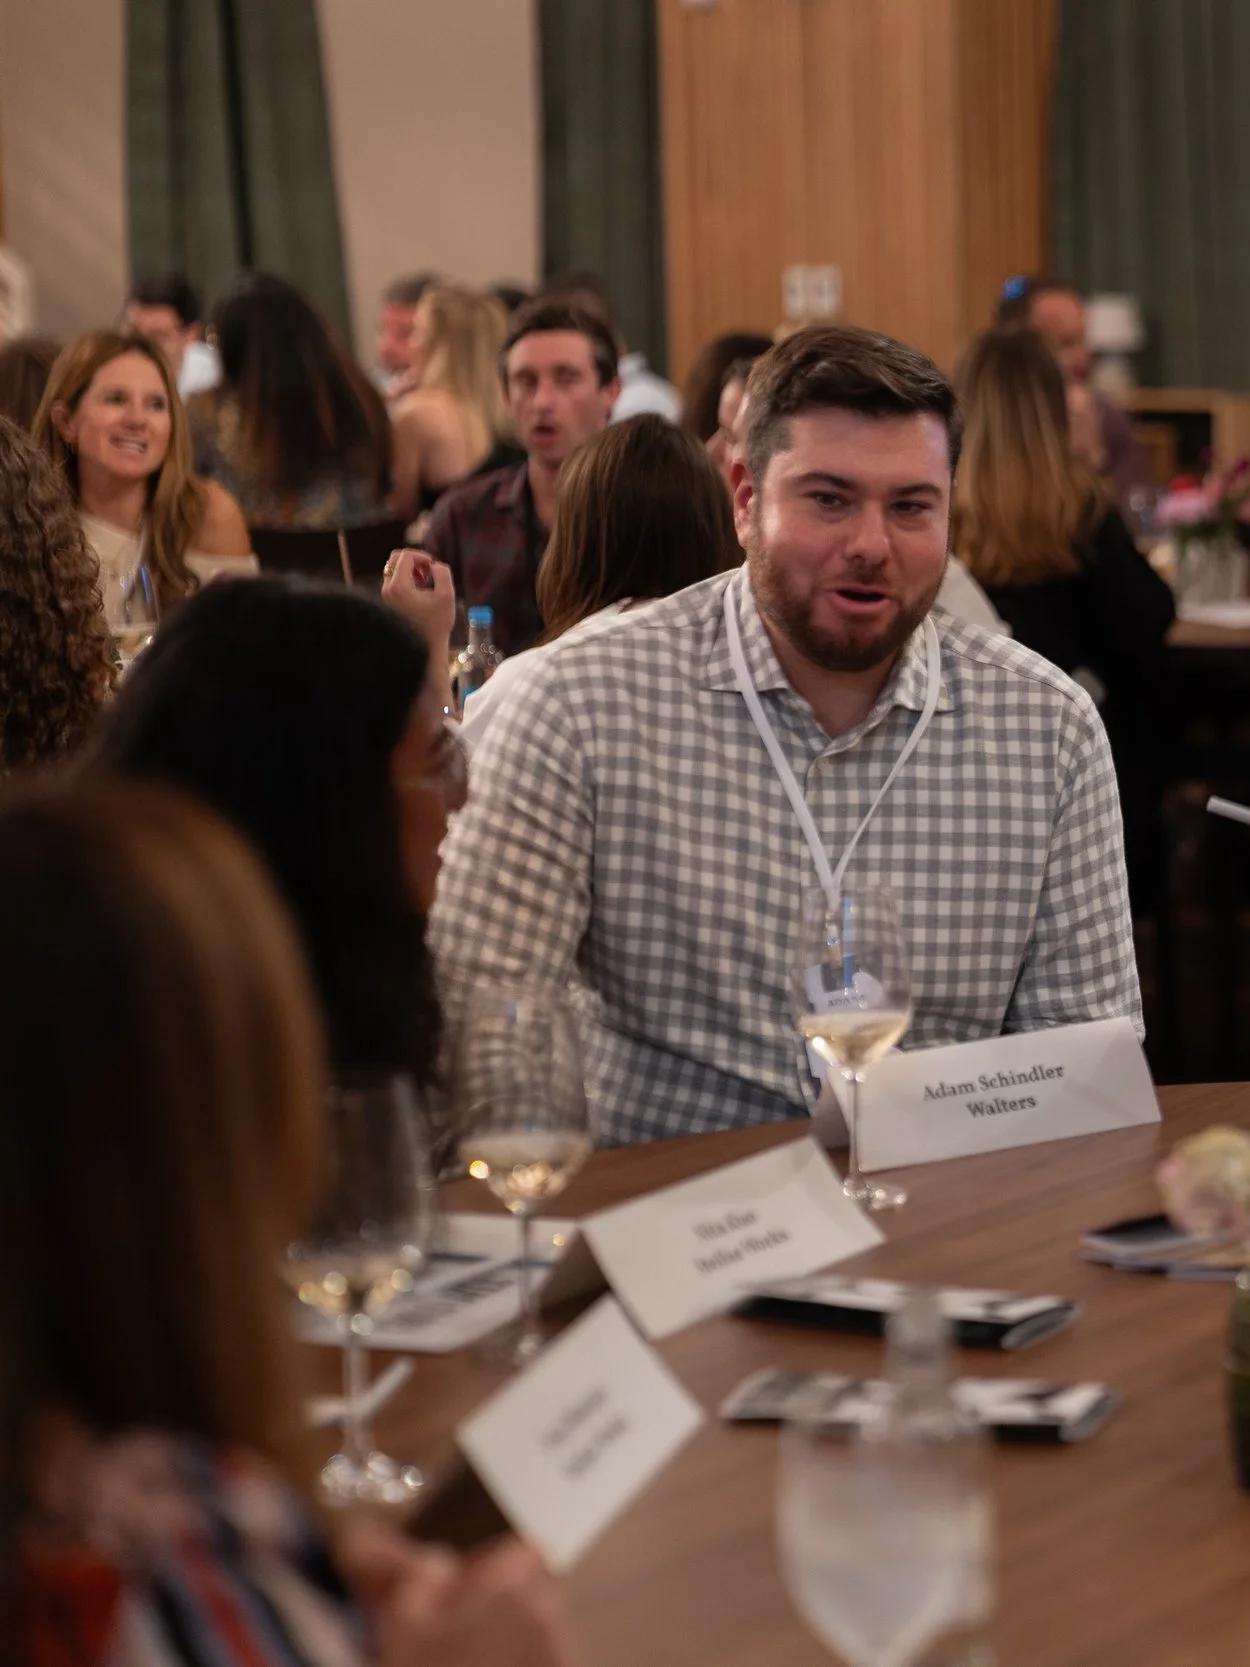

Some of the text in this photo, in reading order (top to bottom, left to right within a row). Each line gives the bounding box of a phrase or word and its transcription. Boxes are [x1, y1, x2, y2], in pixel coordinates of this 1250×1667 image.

[923, 1064, 1064, 1101] Adam Schindler
[966, 1096, 1037, 1118] Walters
